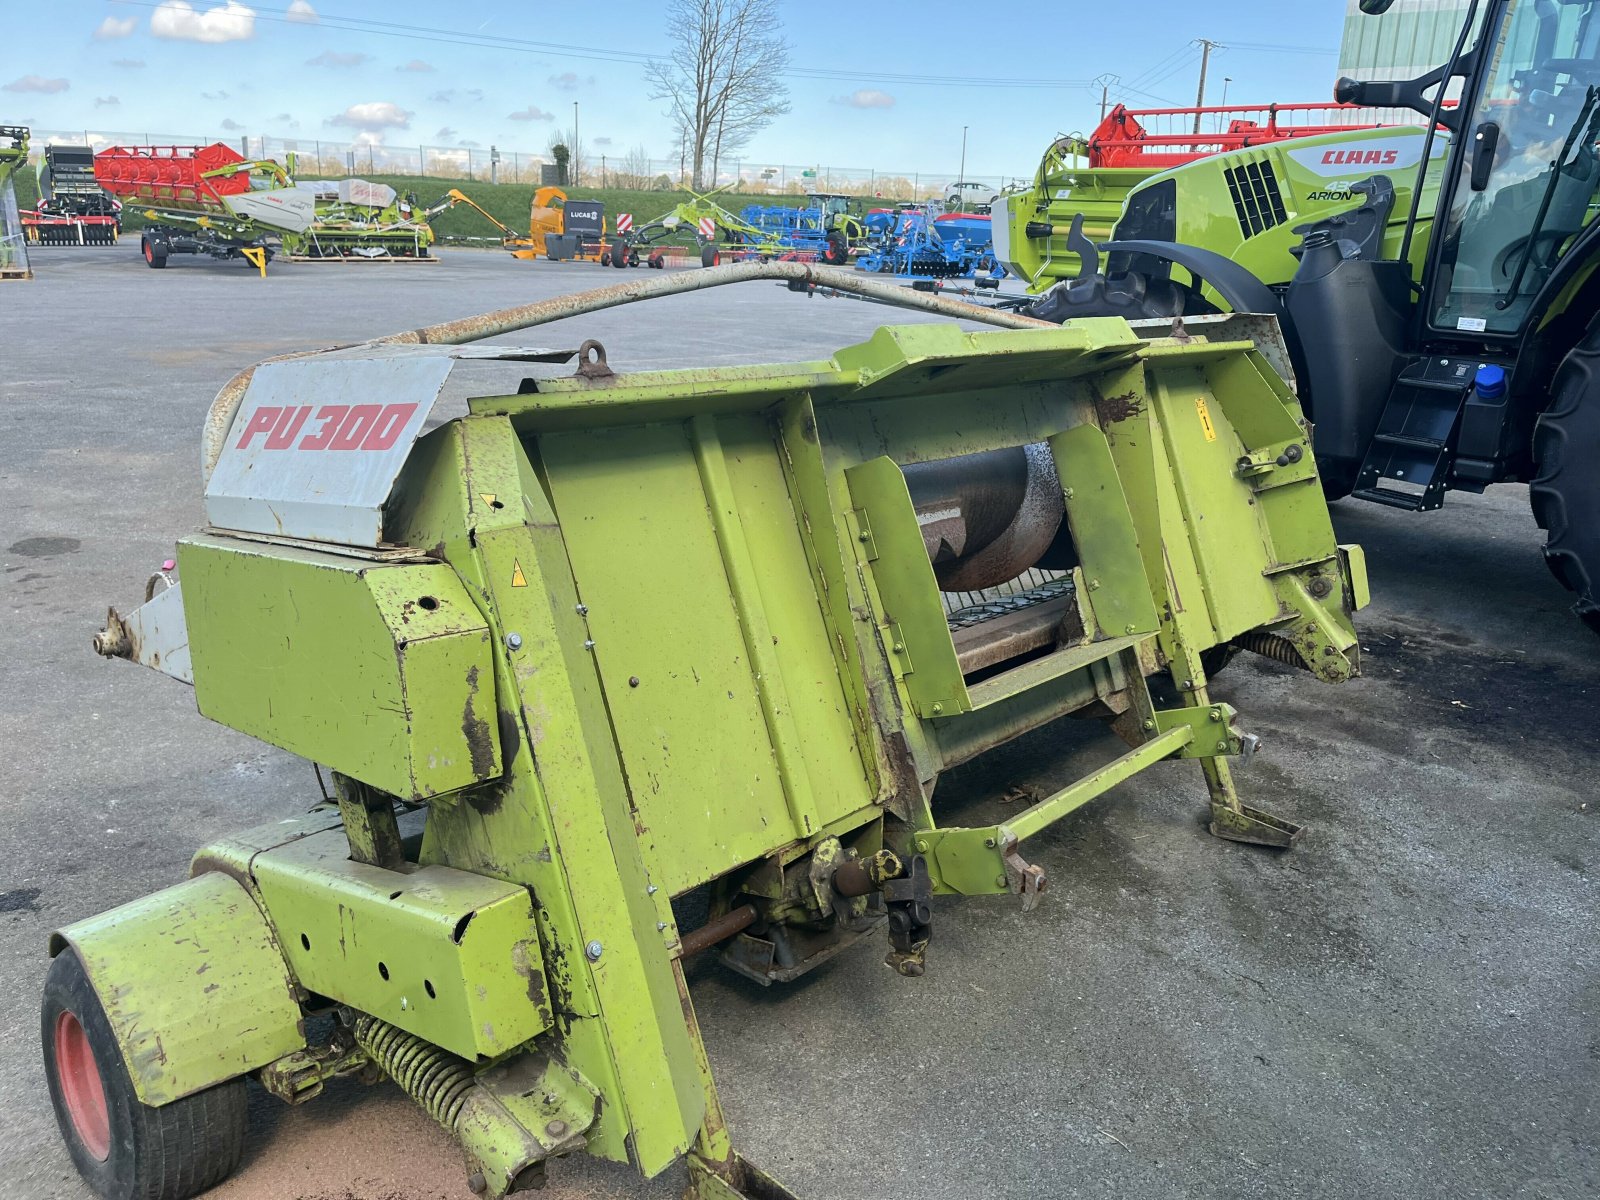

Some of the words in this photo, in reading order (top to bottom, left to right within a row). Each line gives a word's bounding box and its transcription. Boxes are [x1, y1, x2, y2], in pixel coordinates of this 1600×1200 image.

[1321, 150, 1398, 165] CLAAS
[1306, 191, 1353, 200] ARION
[570, 211, 591, 219] LUCAS
[235, 406, 314, 450] PU
[298, 402, 419, 451] 300
